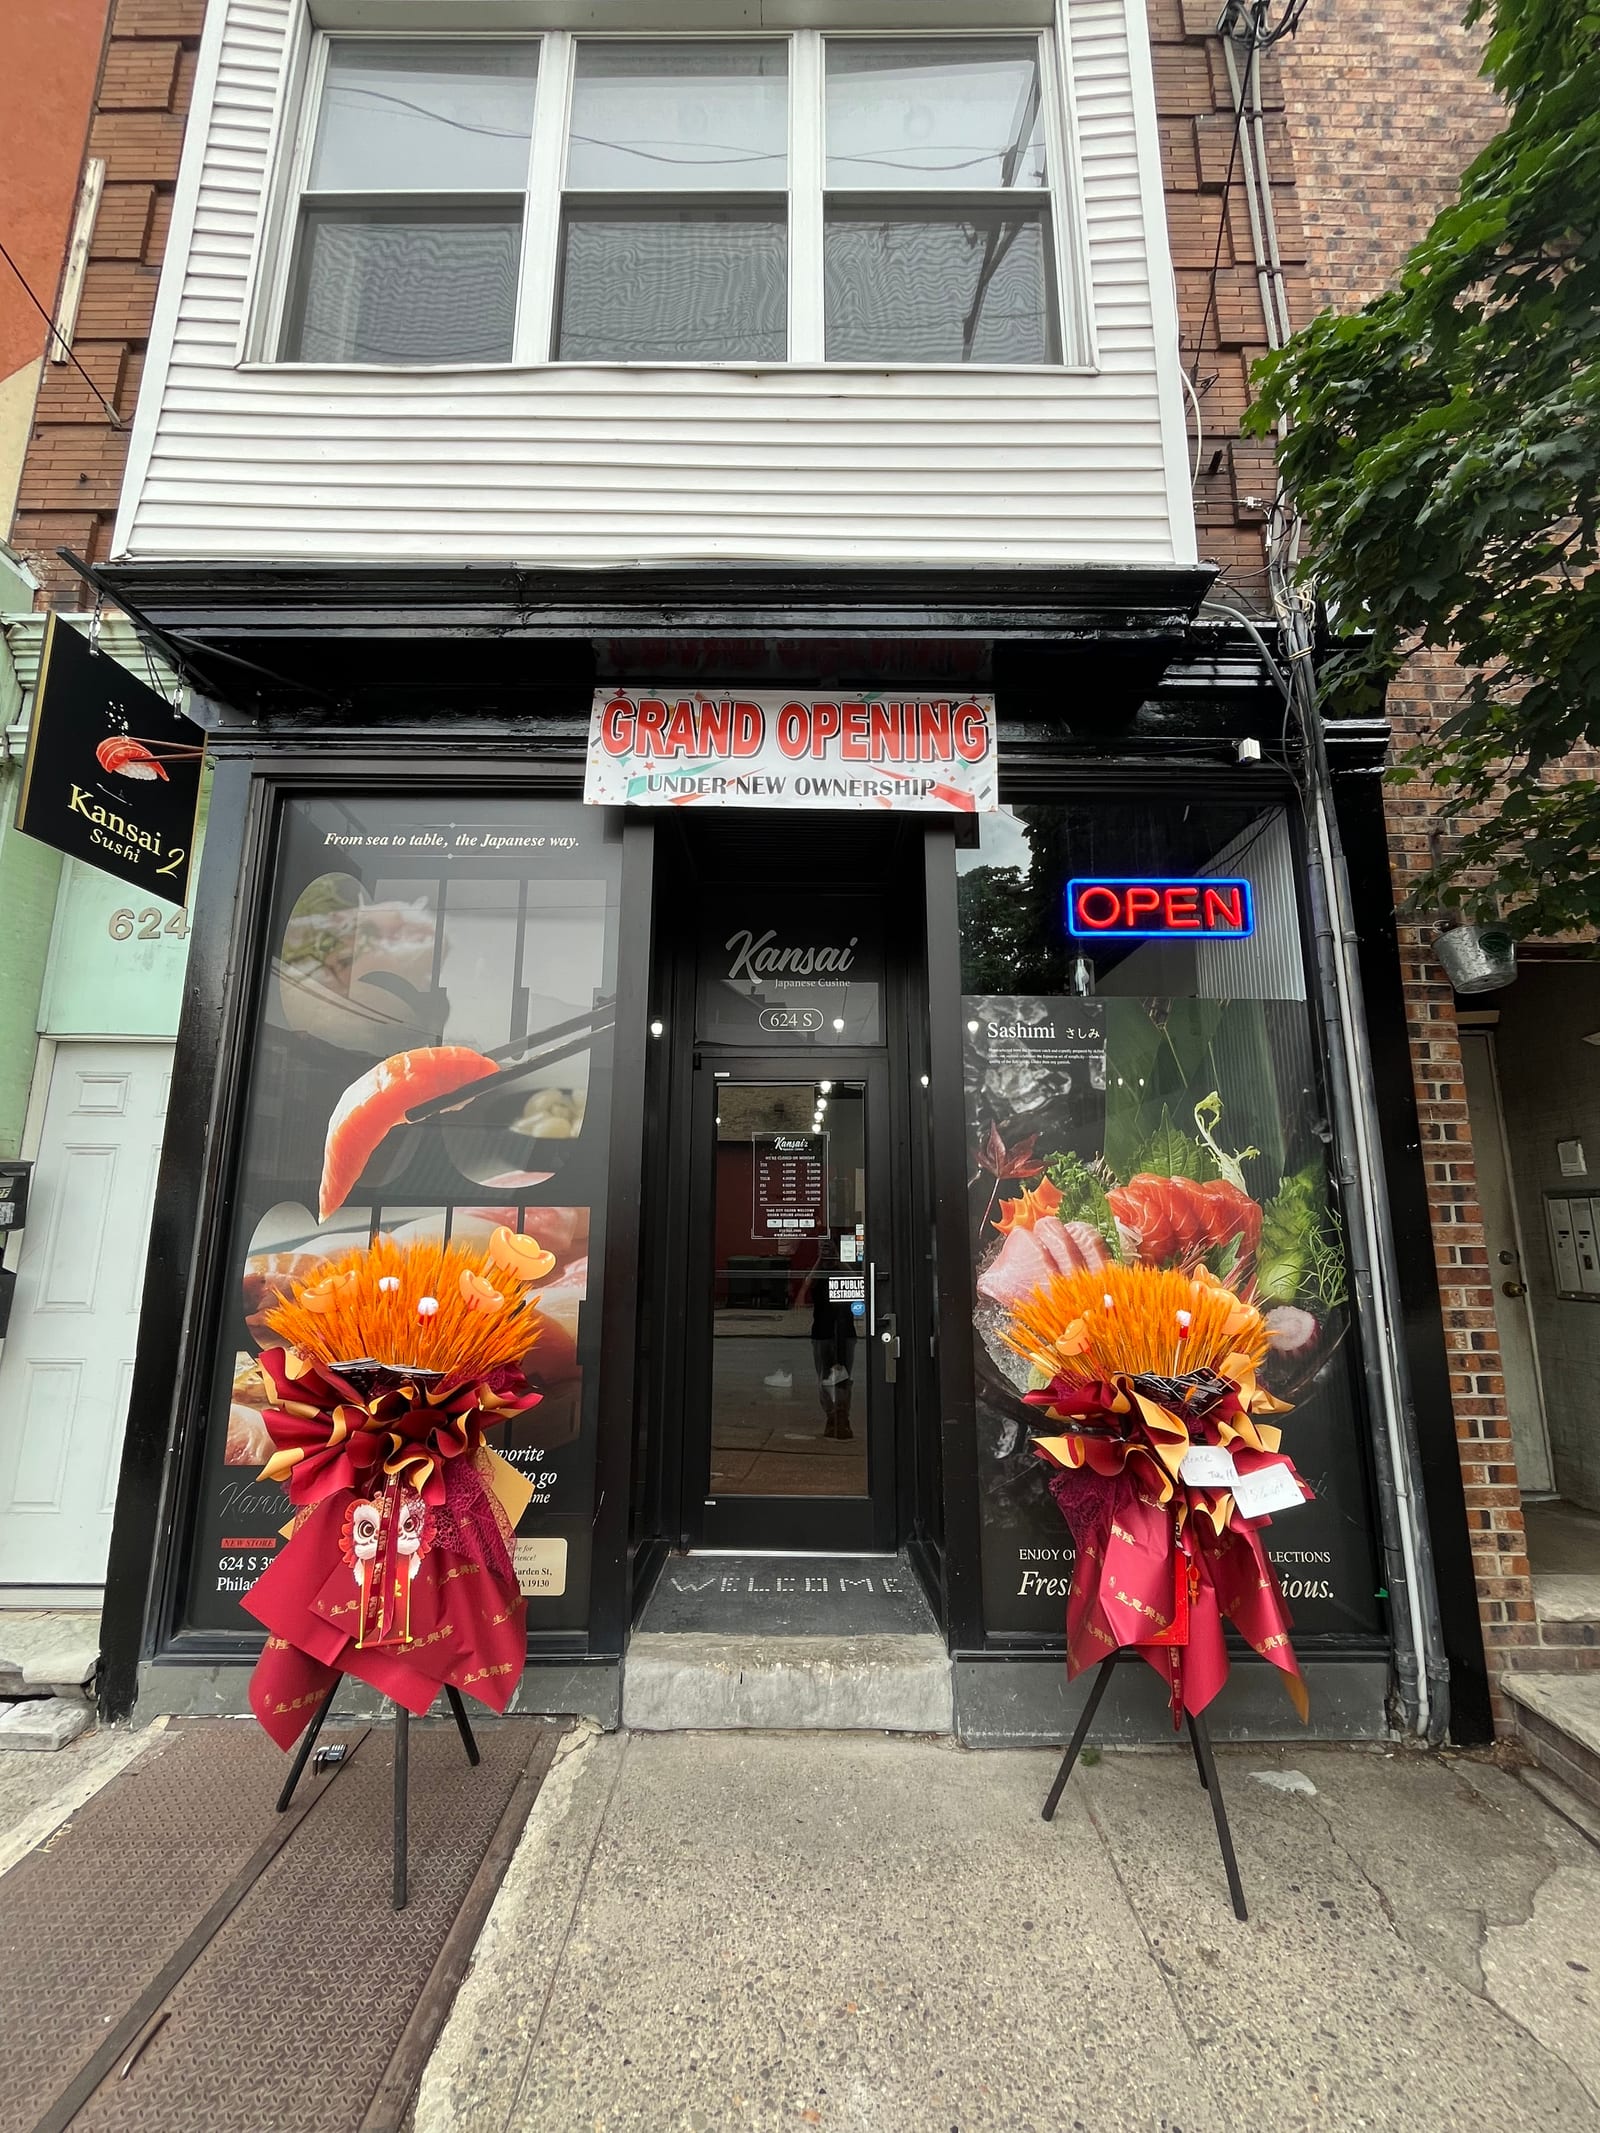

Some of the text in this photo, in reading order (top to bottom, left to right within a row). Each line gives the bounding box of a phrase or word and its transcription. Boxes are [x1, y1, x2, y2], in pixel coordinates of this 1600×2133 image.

[600, 696, 991, 765] GRAND OPENING
[647, 774, 937, 798] UNDER NEW OWNERSHIP
[67, 783, 185, 880] Kansai 2
[89, 828, 140, 864] Sushi
[323, 832, 580, 849] From sea to table, the Japanese way.
[1077, 886, 1243, 929] OPEN
[108, 907, 190, 940] 624
[725, 929, 858, 985] Kansai
[774, 978, 816, 990] Japanese
[770, 1013, 813, 1027] 624 S
[987, 1022, 1056, 1039] Sashimi
[1065, 1027, 1100, 1040] さしみ
[829, 1279, 865, 1290] NO PUBLIC
[829, 1289, 865, 1299] RESTROOMS
[536, 1472, 558, 1489] go
[219, 1481, 297, 1518] Kansa
[224, 1539, 274, 1547] NEW STORE
[1019, 1549, 1059, 1561] ENJOY
[1268, 1551, 1331, 1563] LECTIONS
[218, 1556, 244, 1571] 624
[247, 1556, 257, 1571] S
[528, 1579, 550, 1588] 19130
[670, 1577, 903, 1593] WELCOME
